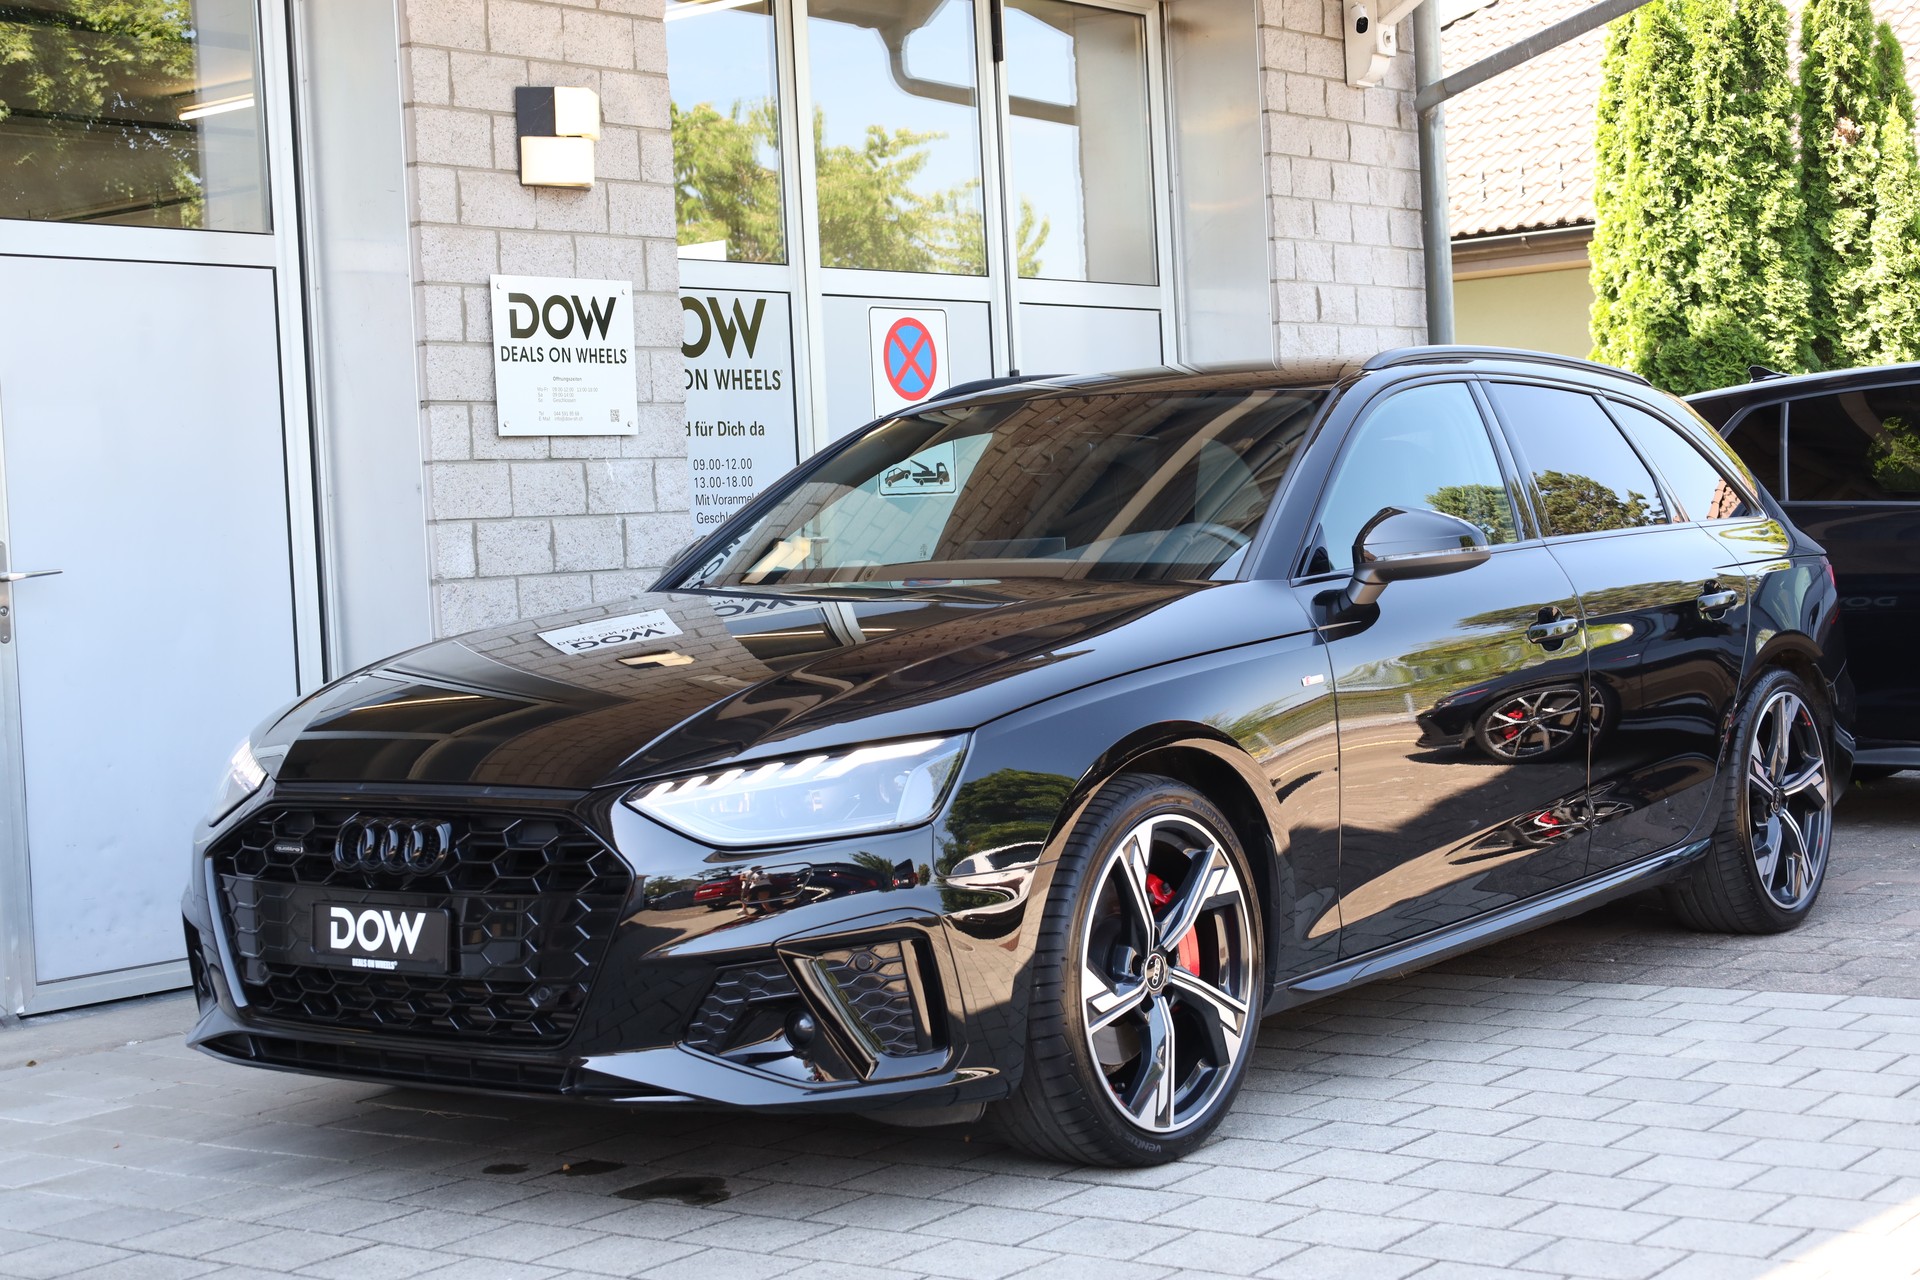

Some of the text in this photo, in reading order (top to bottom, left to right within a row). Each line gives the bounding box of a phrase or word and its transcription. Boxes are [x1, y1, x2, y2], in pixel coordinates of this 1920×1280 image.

[508, 292, 617, 341] DOW
[500, 346, 627, 364] DEALS ON WHEELS
[695, 420, 714, 437] für
[718, 420, 746, 437] Dich
[750, 421, 765, 436] da
[693, 458, 752, 470] 09.00-12.00
[694, 476, 753, 488] 13.00-18.00
[695, 493, 759, 506] Mit Voranmel
[330, 906, 426, 955] DOW
